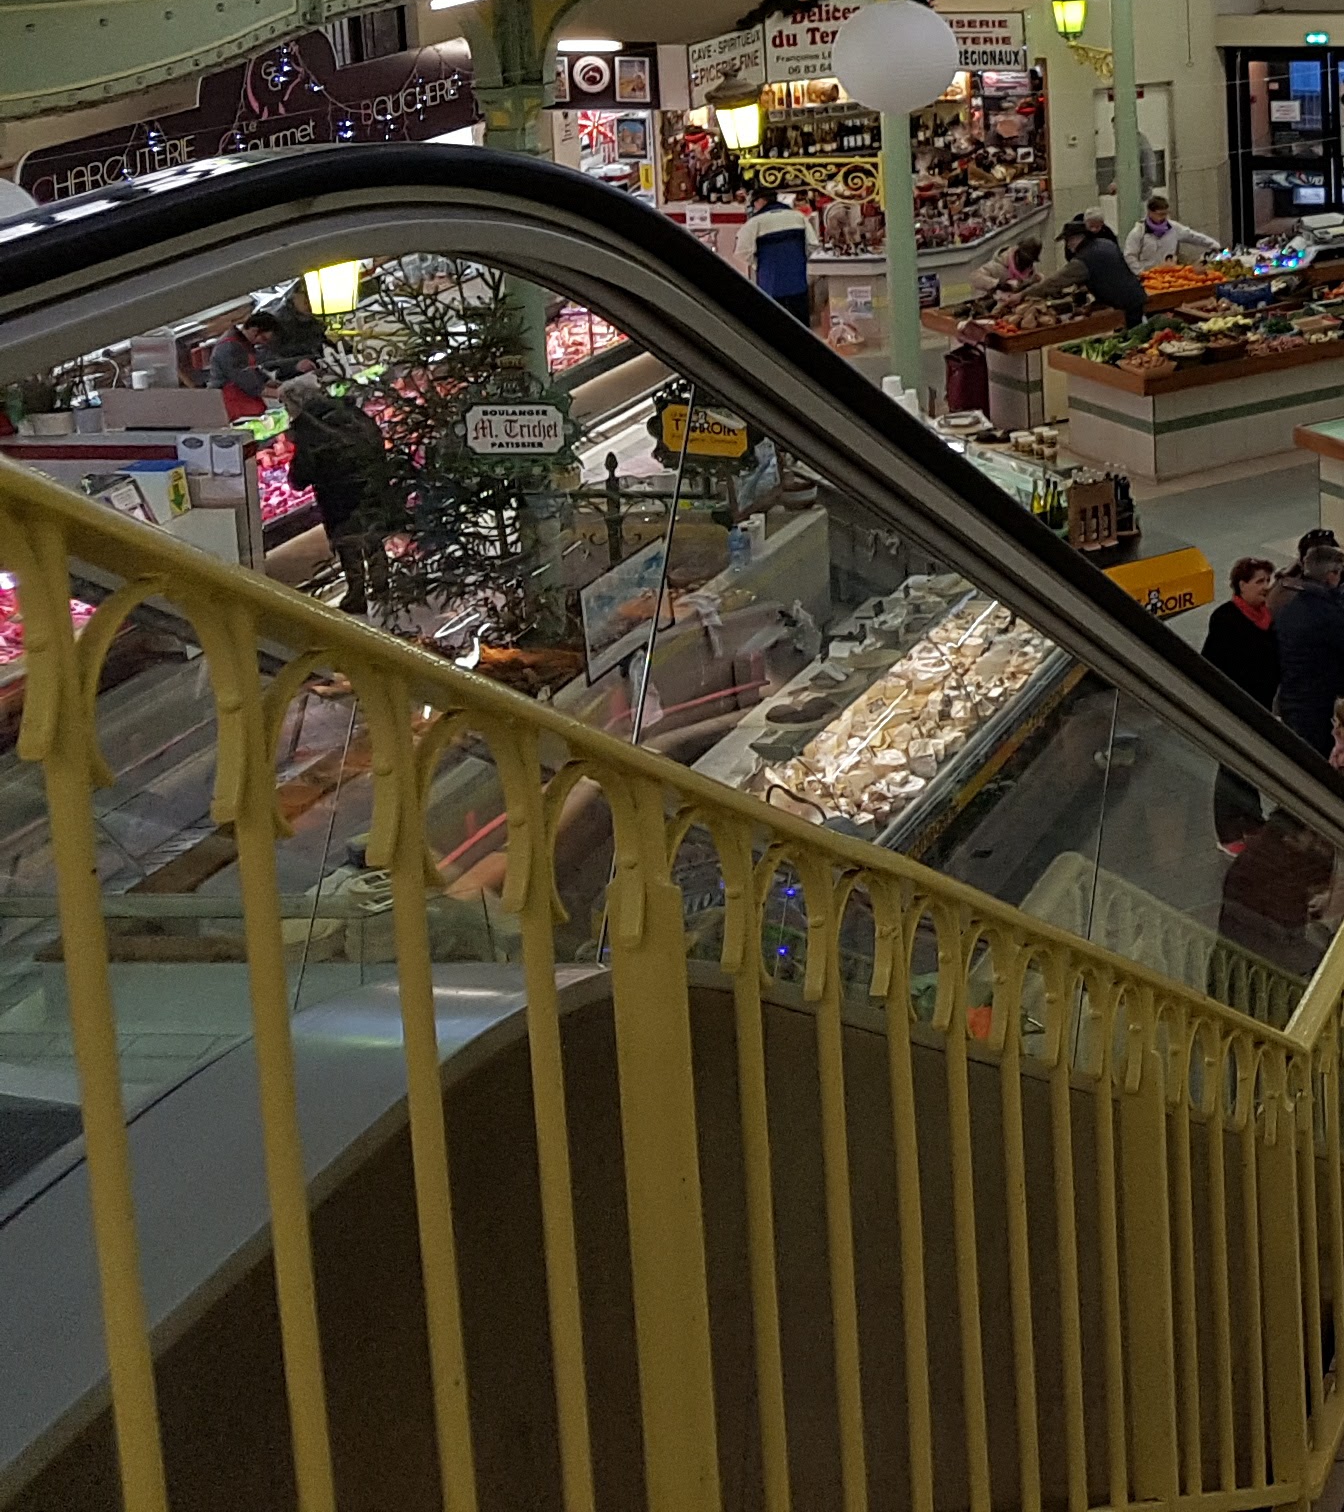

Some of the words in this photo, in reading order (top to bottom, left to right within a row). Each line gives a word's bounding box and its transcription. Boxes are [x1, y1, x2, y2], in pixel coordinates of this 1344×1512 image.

[950, 19, 1008, 29] ISERIE
[771, 29, 798, 49] du
[957, 36, 1012, 46] TERIE
[692, 44, 712, 64] CAVE
[360, 76, 460, 126] BOUCHERIE
[242, 121, 258, 134] Le
[32, 135, 196, 206] CHARCUTERIE
[481, 408, 548, 417] BOULANGER
[490, 441, 544, 449] PATISSIER
